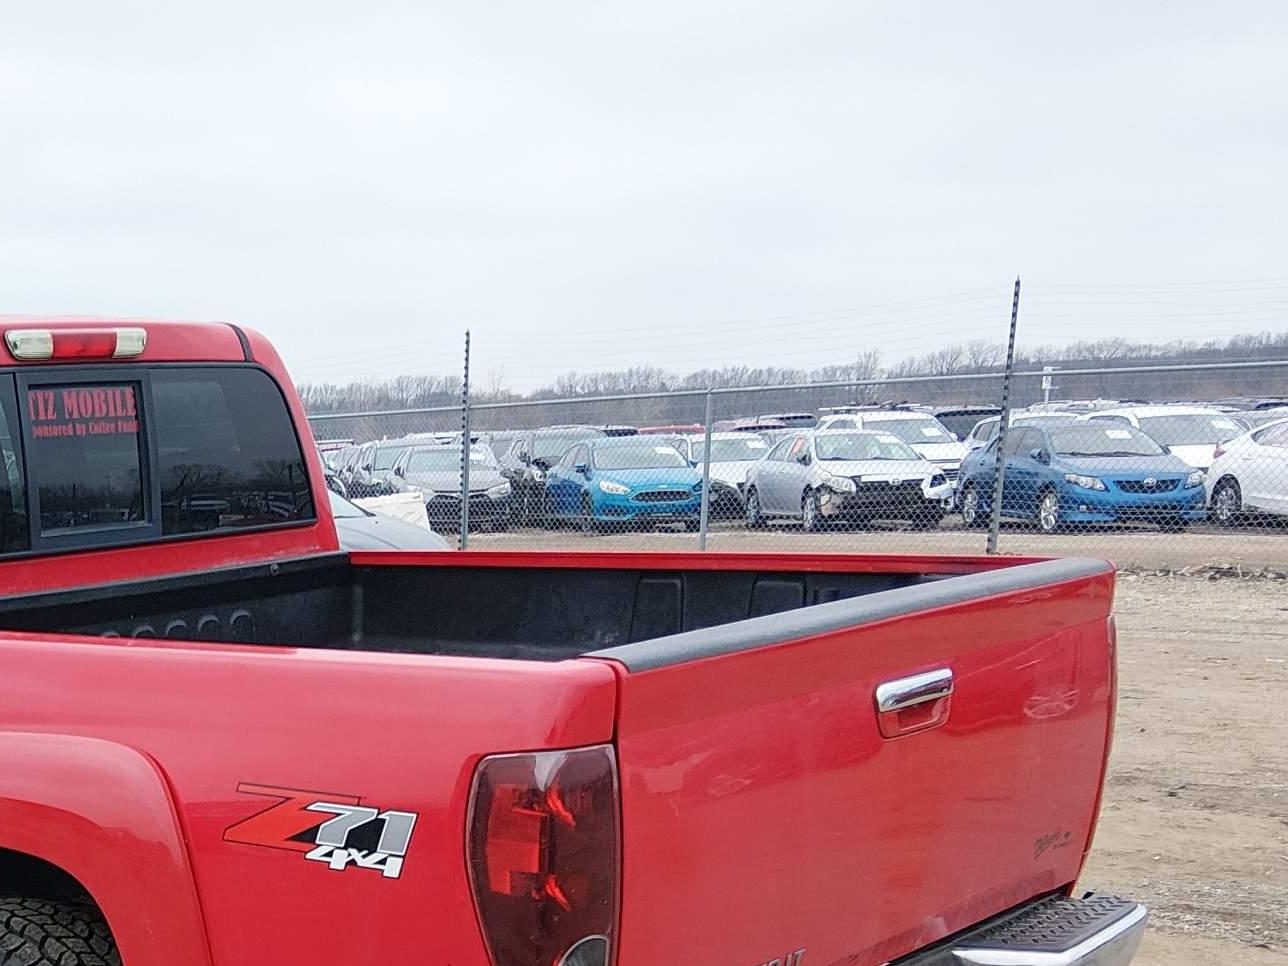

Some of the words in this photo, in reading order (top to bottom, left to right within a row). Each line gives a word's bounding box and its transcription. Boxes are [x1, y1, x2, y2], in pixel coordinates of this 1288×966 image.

[63, 387, 137, 419] MOBILE
[75, 422, 87, 438] by
[222, 782, 420, 857] Z71
